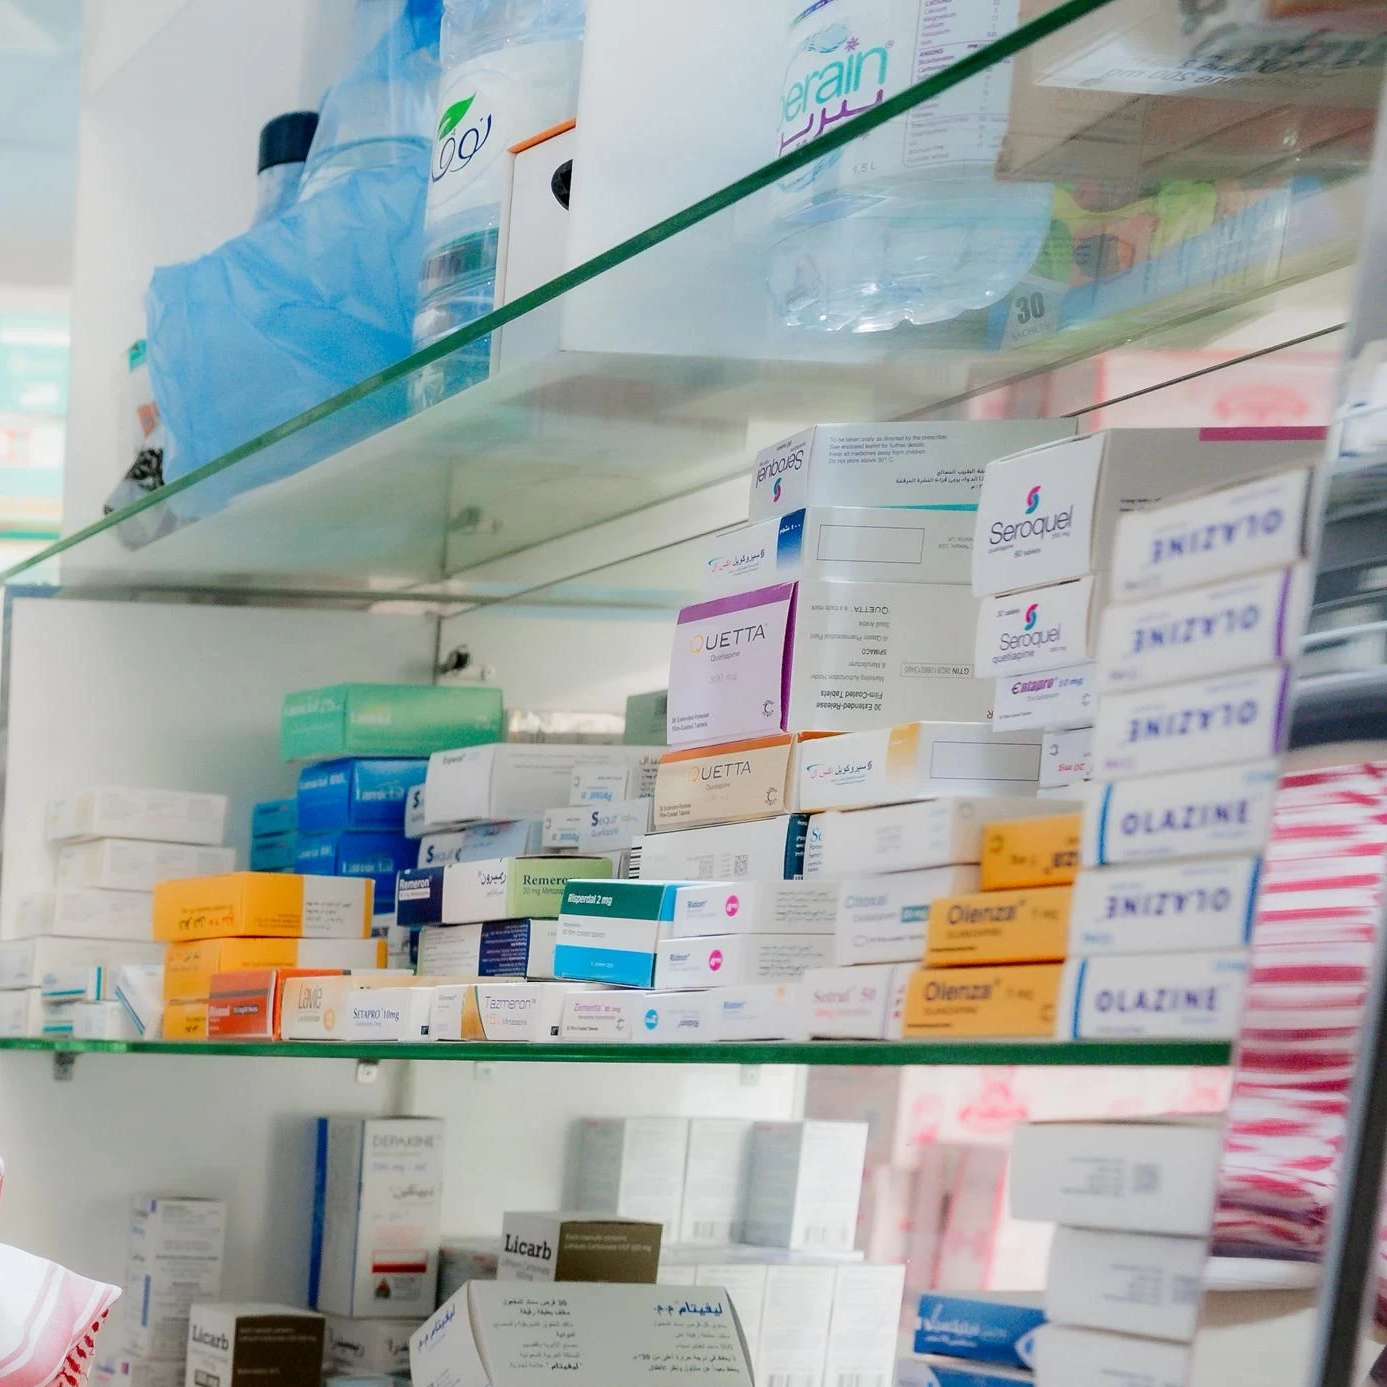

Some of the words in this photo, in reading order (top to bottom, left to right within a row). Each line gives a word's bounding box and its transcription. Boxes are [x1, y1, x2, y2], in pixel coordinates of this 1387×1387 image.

[781, 40, 888, 123] erain
[1015, 291, 1045, 324] 30
[756, 449, 804, 488] Seroquel
[989, 504, 1074, 546] Seroquel
[999, 622, 1062, 652] Seroquel
[951, 667, 970, 676] GTIN
[522, 873, 569, 887] Remero
[567, 892, 596, 905] Risperdal
[601, 897, 613, 906] mg
[504, 1234, 552, 1261] Licarb
[191, 1324, 229, 1351] Licarb
